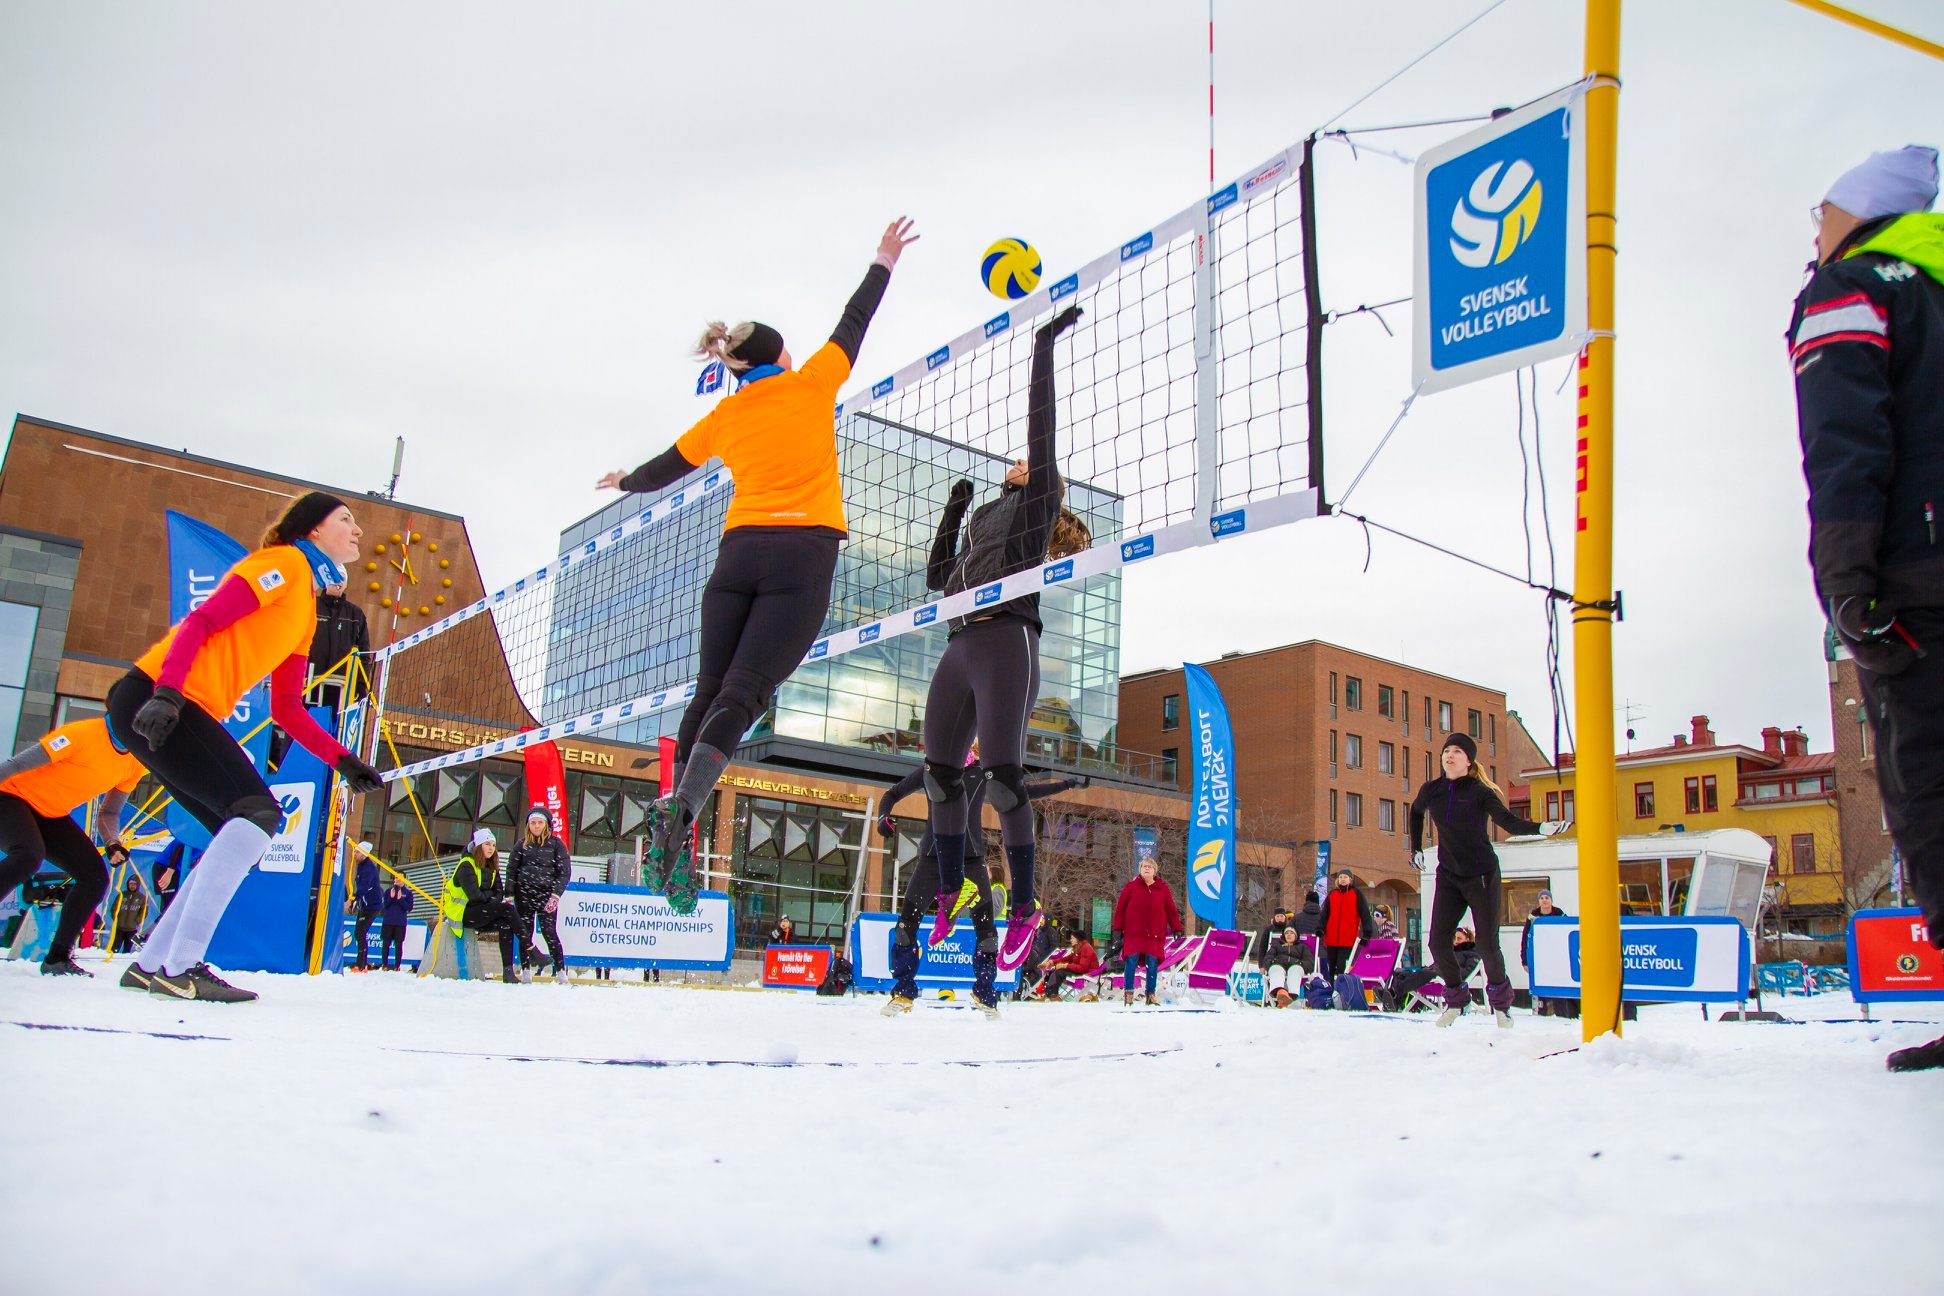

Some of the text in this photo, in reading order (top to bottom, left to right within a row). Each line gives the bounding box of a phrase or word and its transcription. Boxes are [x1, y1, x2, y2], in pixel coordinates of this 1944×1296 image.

[1460, 275, 1528, 317] SVENSK
[1441, 294, 1551, 346] VOLLEYBOLL
[271, 843, 294, 852] SVENSK
[264, 853, 300, 862] VOLLEYBOLL
[578, 901, 628, 915] SWEDISH
[564, 916, 714, 933] NATIONAL CHAMPIONSHIPS
[589, 930, 657, 946] ÖSTERSUND
[1622, 944, 1657, 956] VENSK
[1623, 957, 1684, 970] OLLEYBOLL
